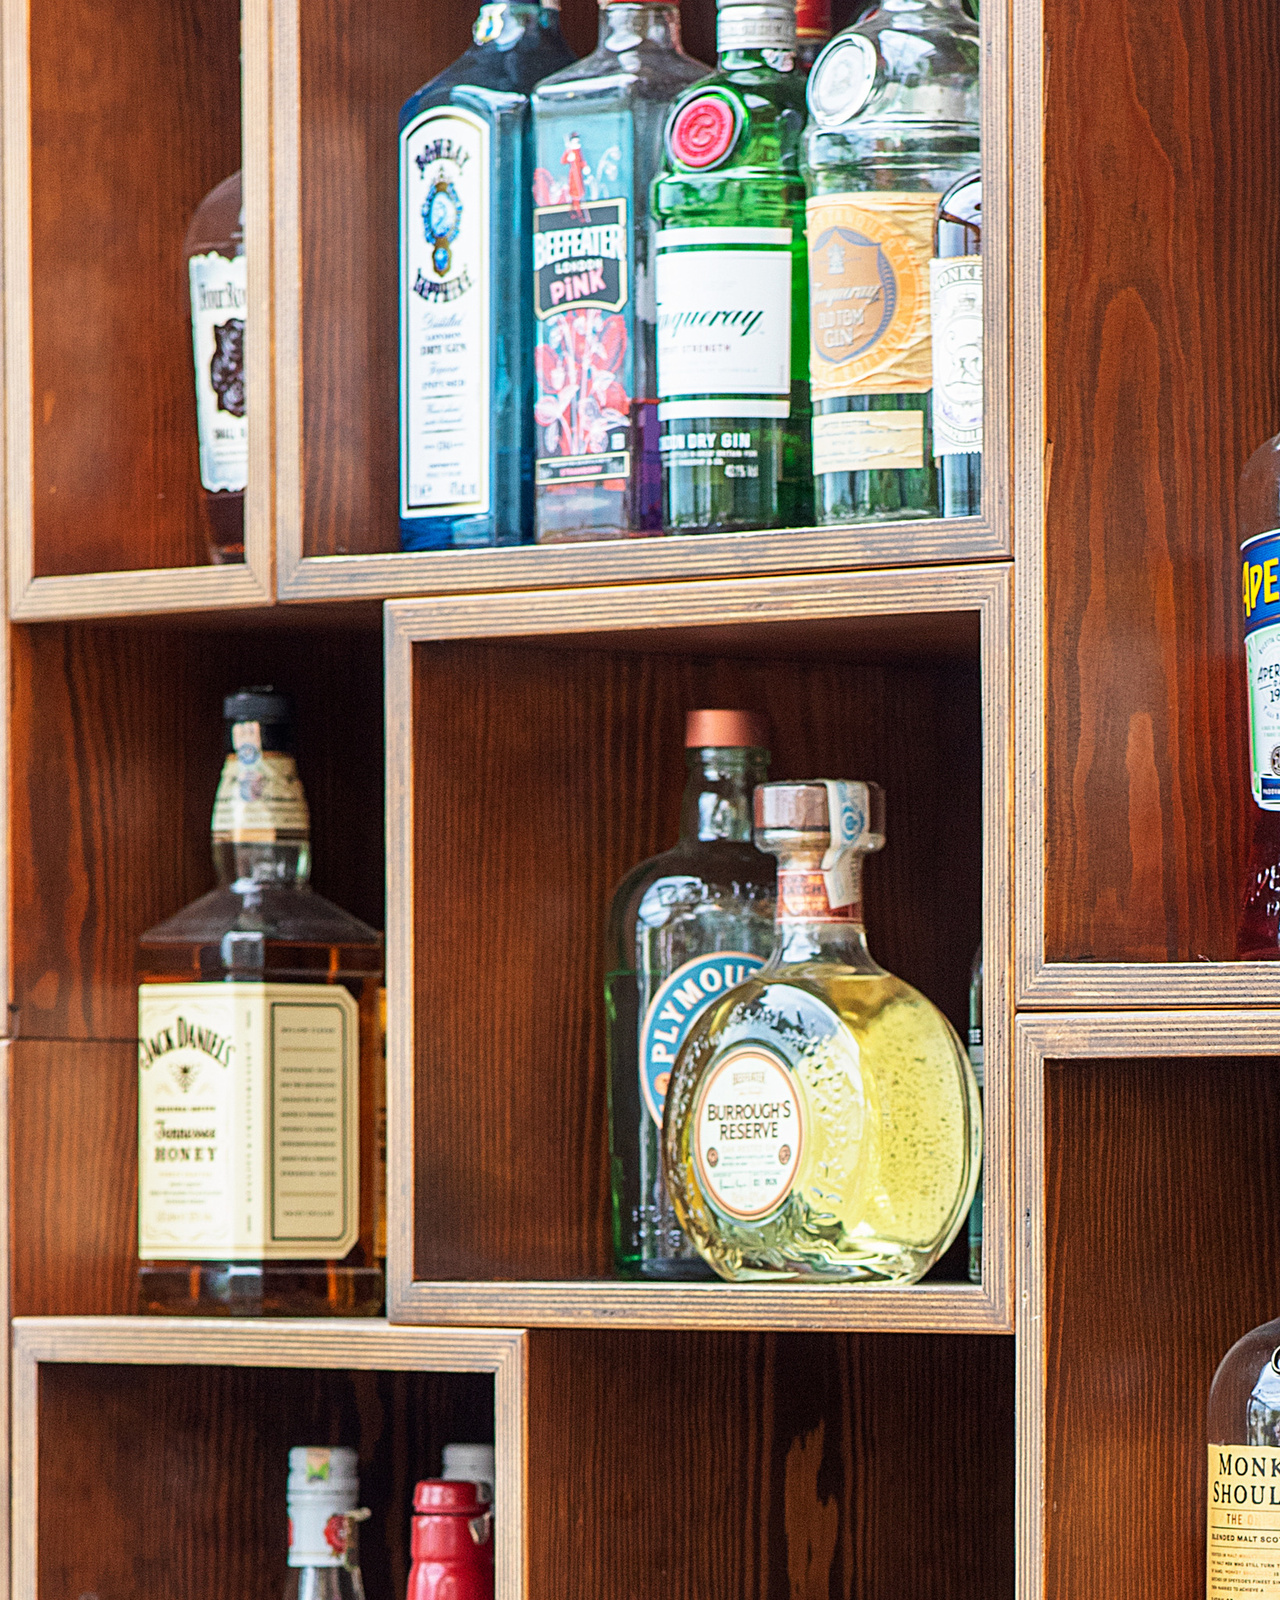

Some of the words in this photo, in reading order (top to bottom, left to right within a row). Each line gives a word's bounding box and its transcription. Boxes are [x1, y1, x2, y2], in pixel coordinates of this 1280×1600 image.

[533, 223, 626, 271] BEEFEATER
[555, 258, 603, 274] LONDON
[721, 432, 750, 448] GIN
[651, 964, 757, 1063] PLYMOU
[140, 1028, 174, 1069] JACK
[708, 1100, 791, 1121] BURROUGH'S
[155, 1120, 216, 1140] Tennessee
[720, 1122, 778, 1140] RESERVE
[154, 1147, 217, 1162] HONEY
[1227, 1514, 1242, 1525] THE
[1237, 1535, 1258, 1543] MALT
